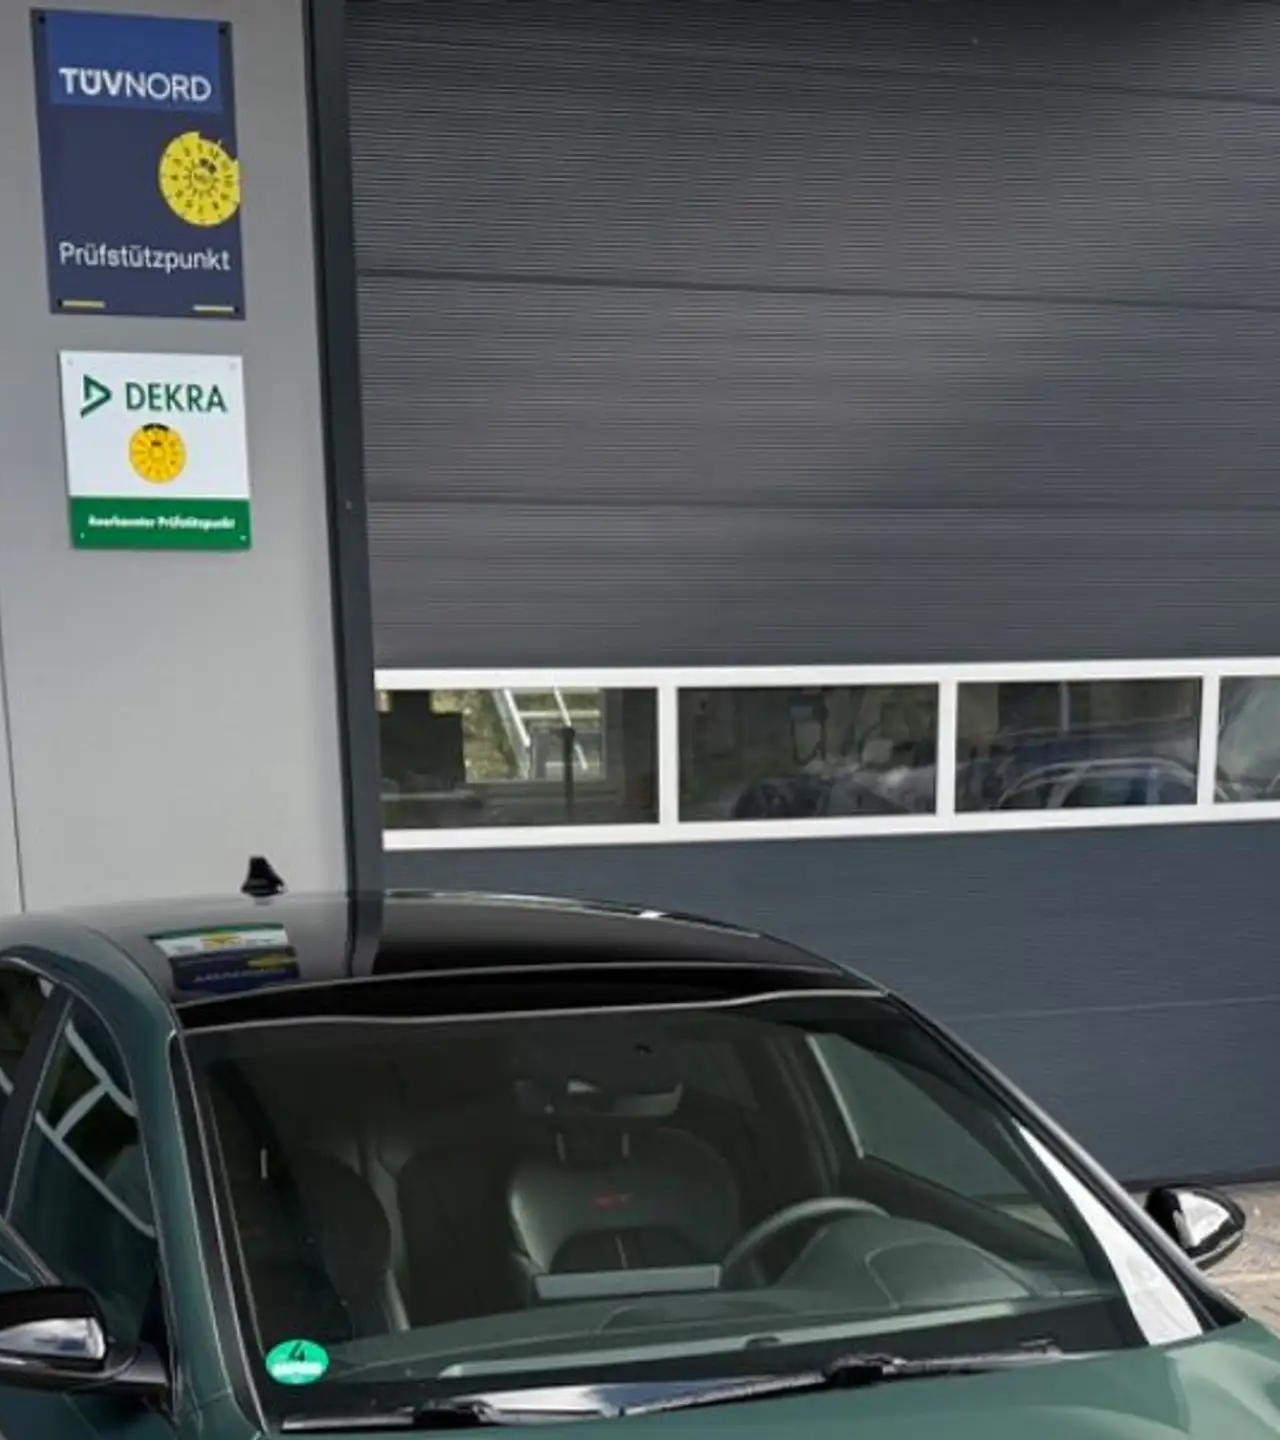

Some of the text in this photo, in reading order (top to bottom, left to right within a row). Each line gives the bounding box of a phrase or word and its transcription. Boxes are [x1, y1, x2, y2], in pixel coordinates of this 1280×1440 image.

[58, 66, 212, 102] TÜVNORD
[58, 241, 231, 275] Prüfstützpunkt
[125, 382, 228, 413] DEKRA
